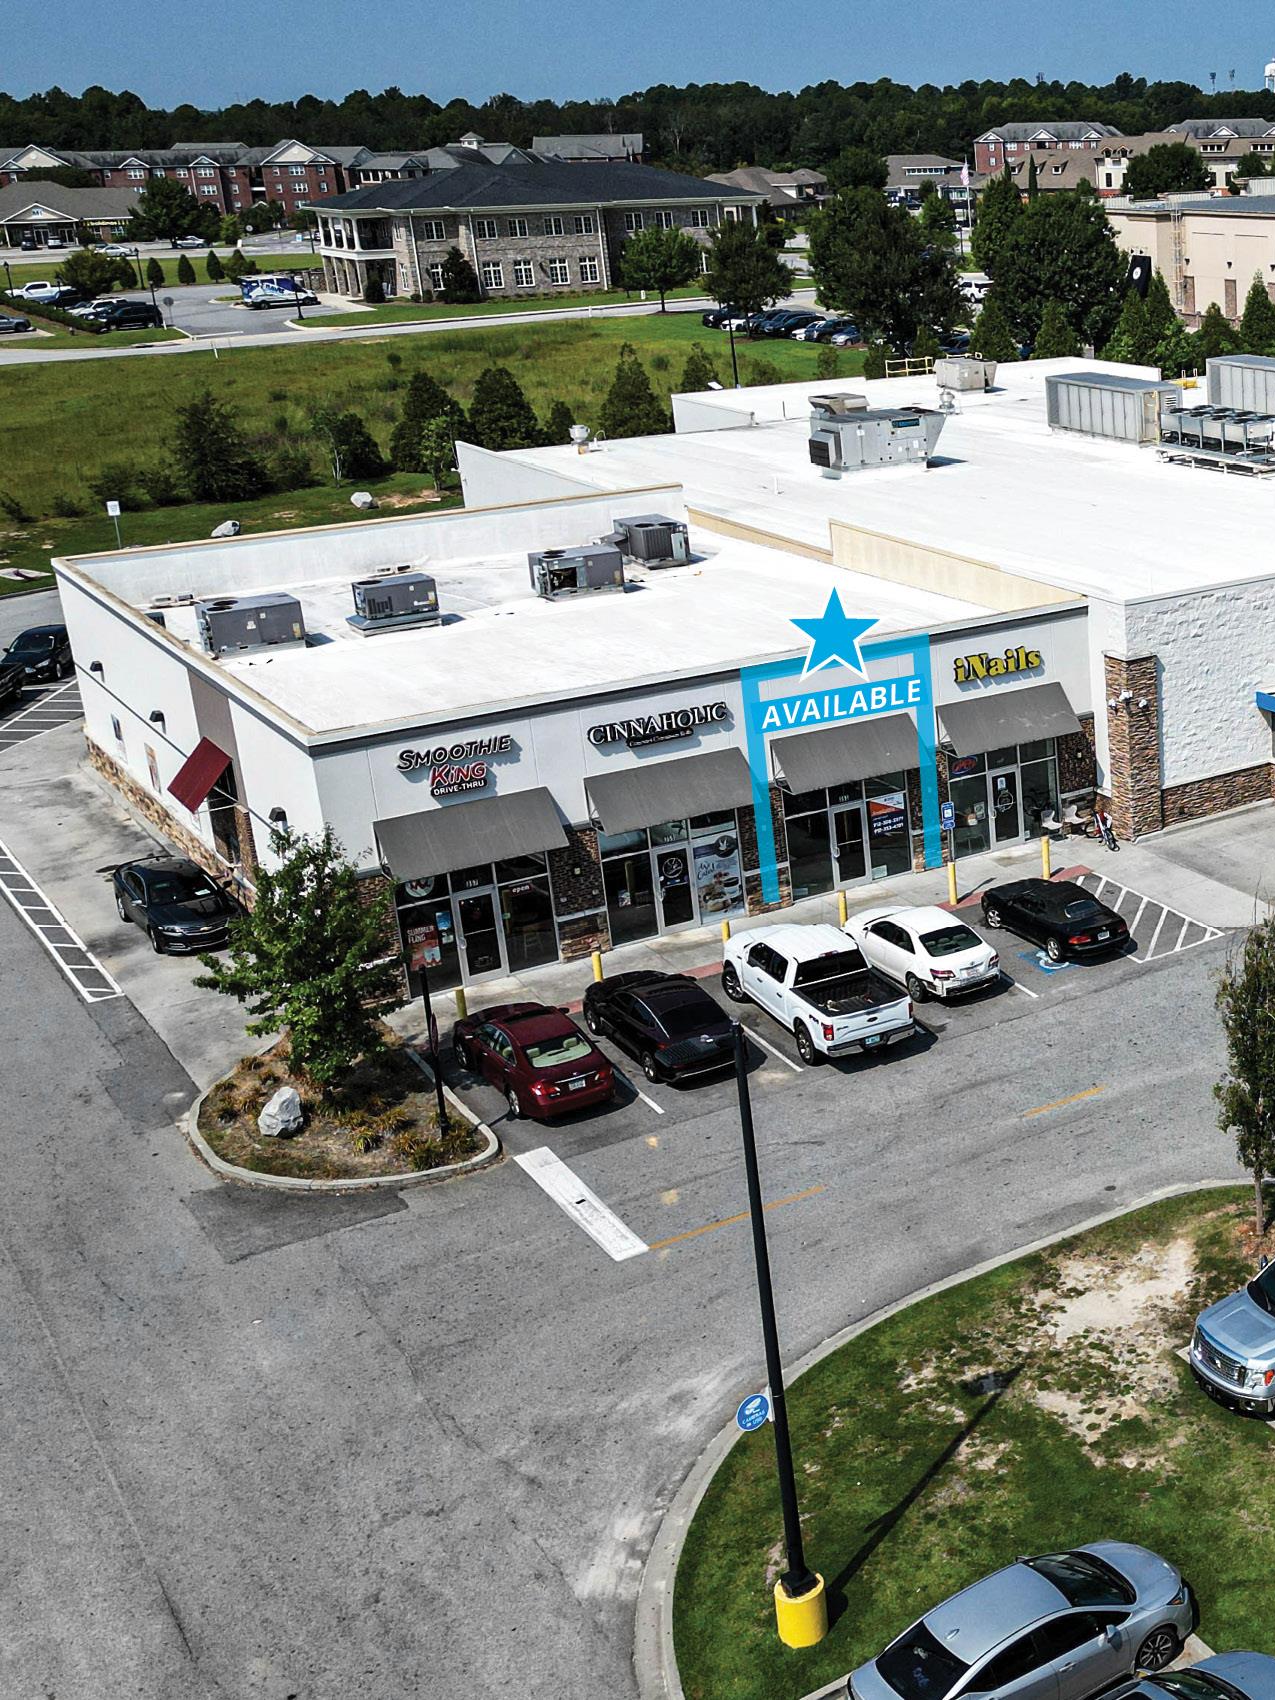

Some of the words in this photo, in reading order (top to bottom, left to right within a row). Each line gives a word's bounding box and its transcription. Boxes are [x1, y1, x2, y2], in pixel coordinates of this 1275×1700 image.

[953, 646, 1040, 682] iNails
[588, 702, 727, 745] CINNAHOLIC
[396, 734, 511, 772] SMOOTHIE
[433, 780, 485, 796] DRIVE-THRU
[512, 884, 530, 894] open
[406, 925, 434, 936] SUMMER
[408, 934, 426, 944] FLING
